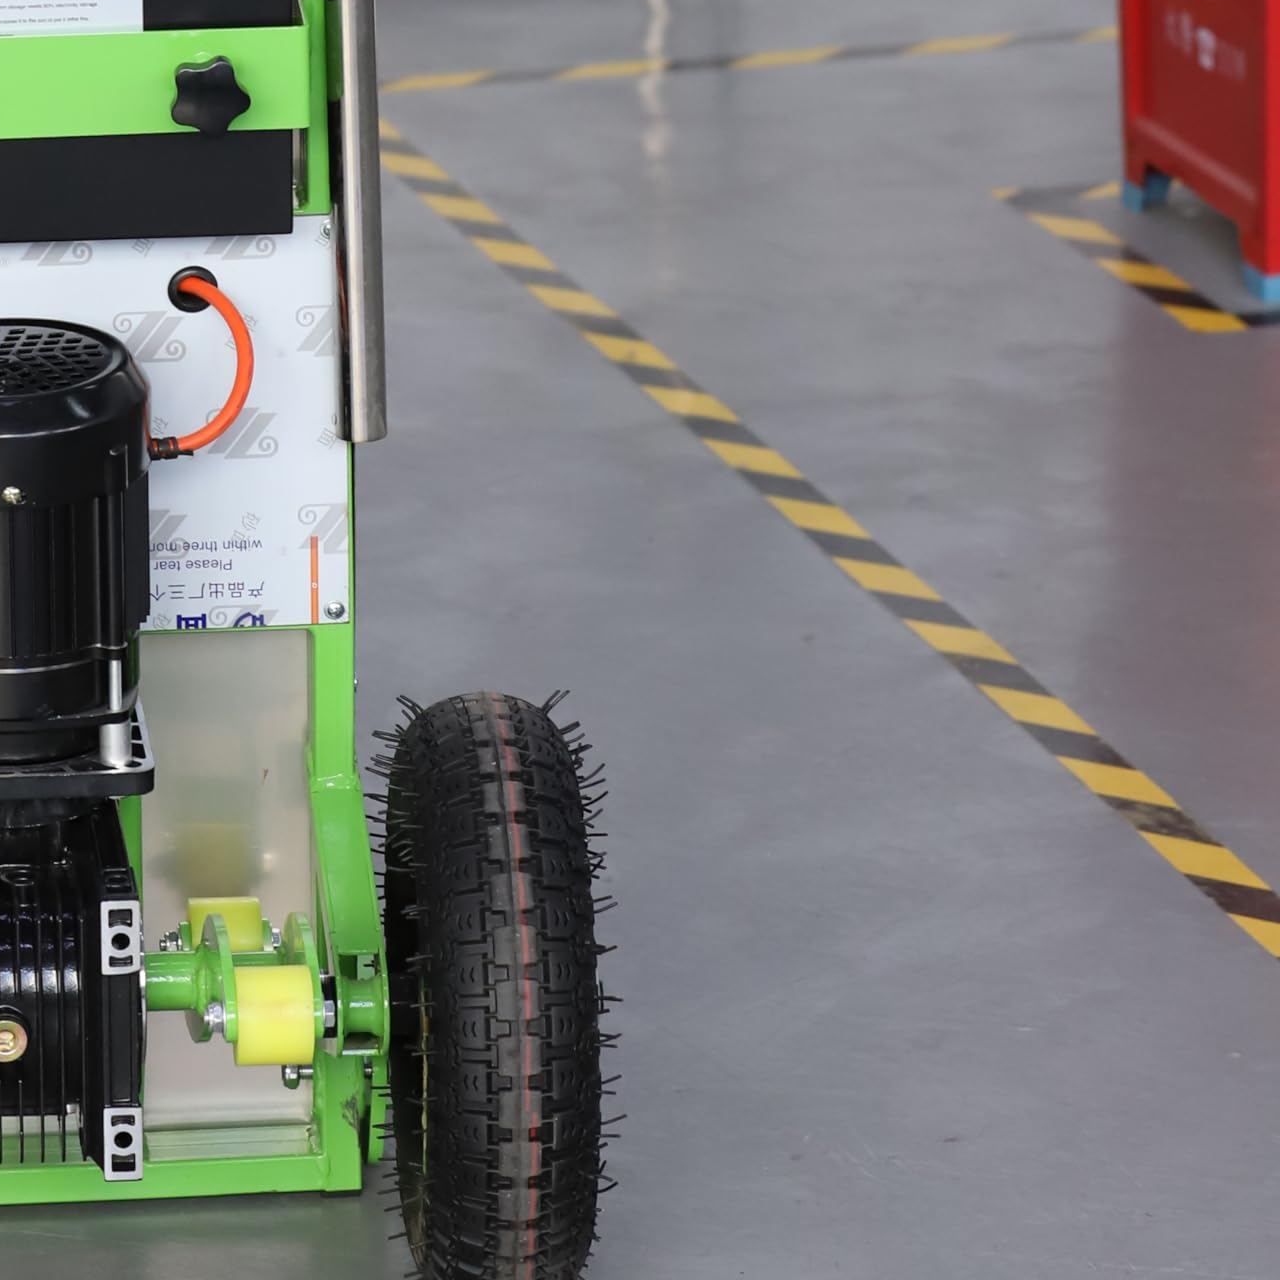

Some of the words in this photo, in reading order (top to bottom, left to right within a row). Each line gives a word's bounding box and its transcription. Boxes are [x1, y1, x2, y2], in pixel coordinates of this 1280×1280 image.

[182, 540, 218, 552] three
[222, 539, 263, 552] within
[153, 560, 181, 571] tear
[185, 559, 232, 571] Please
